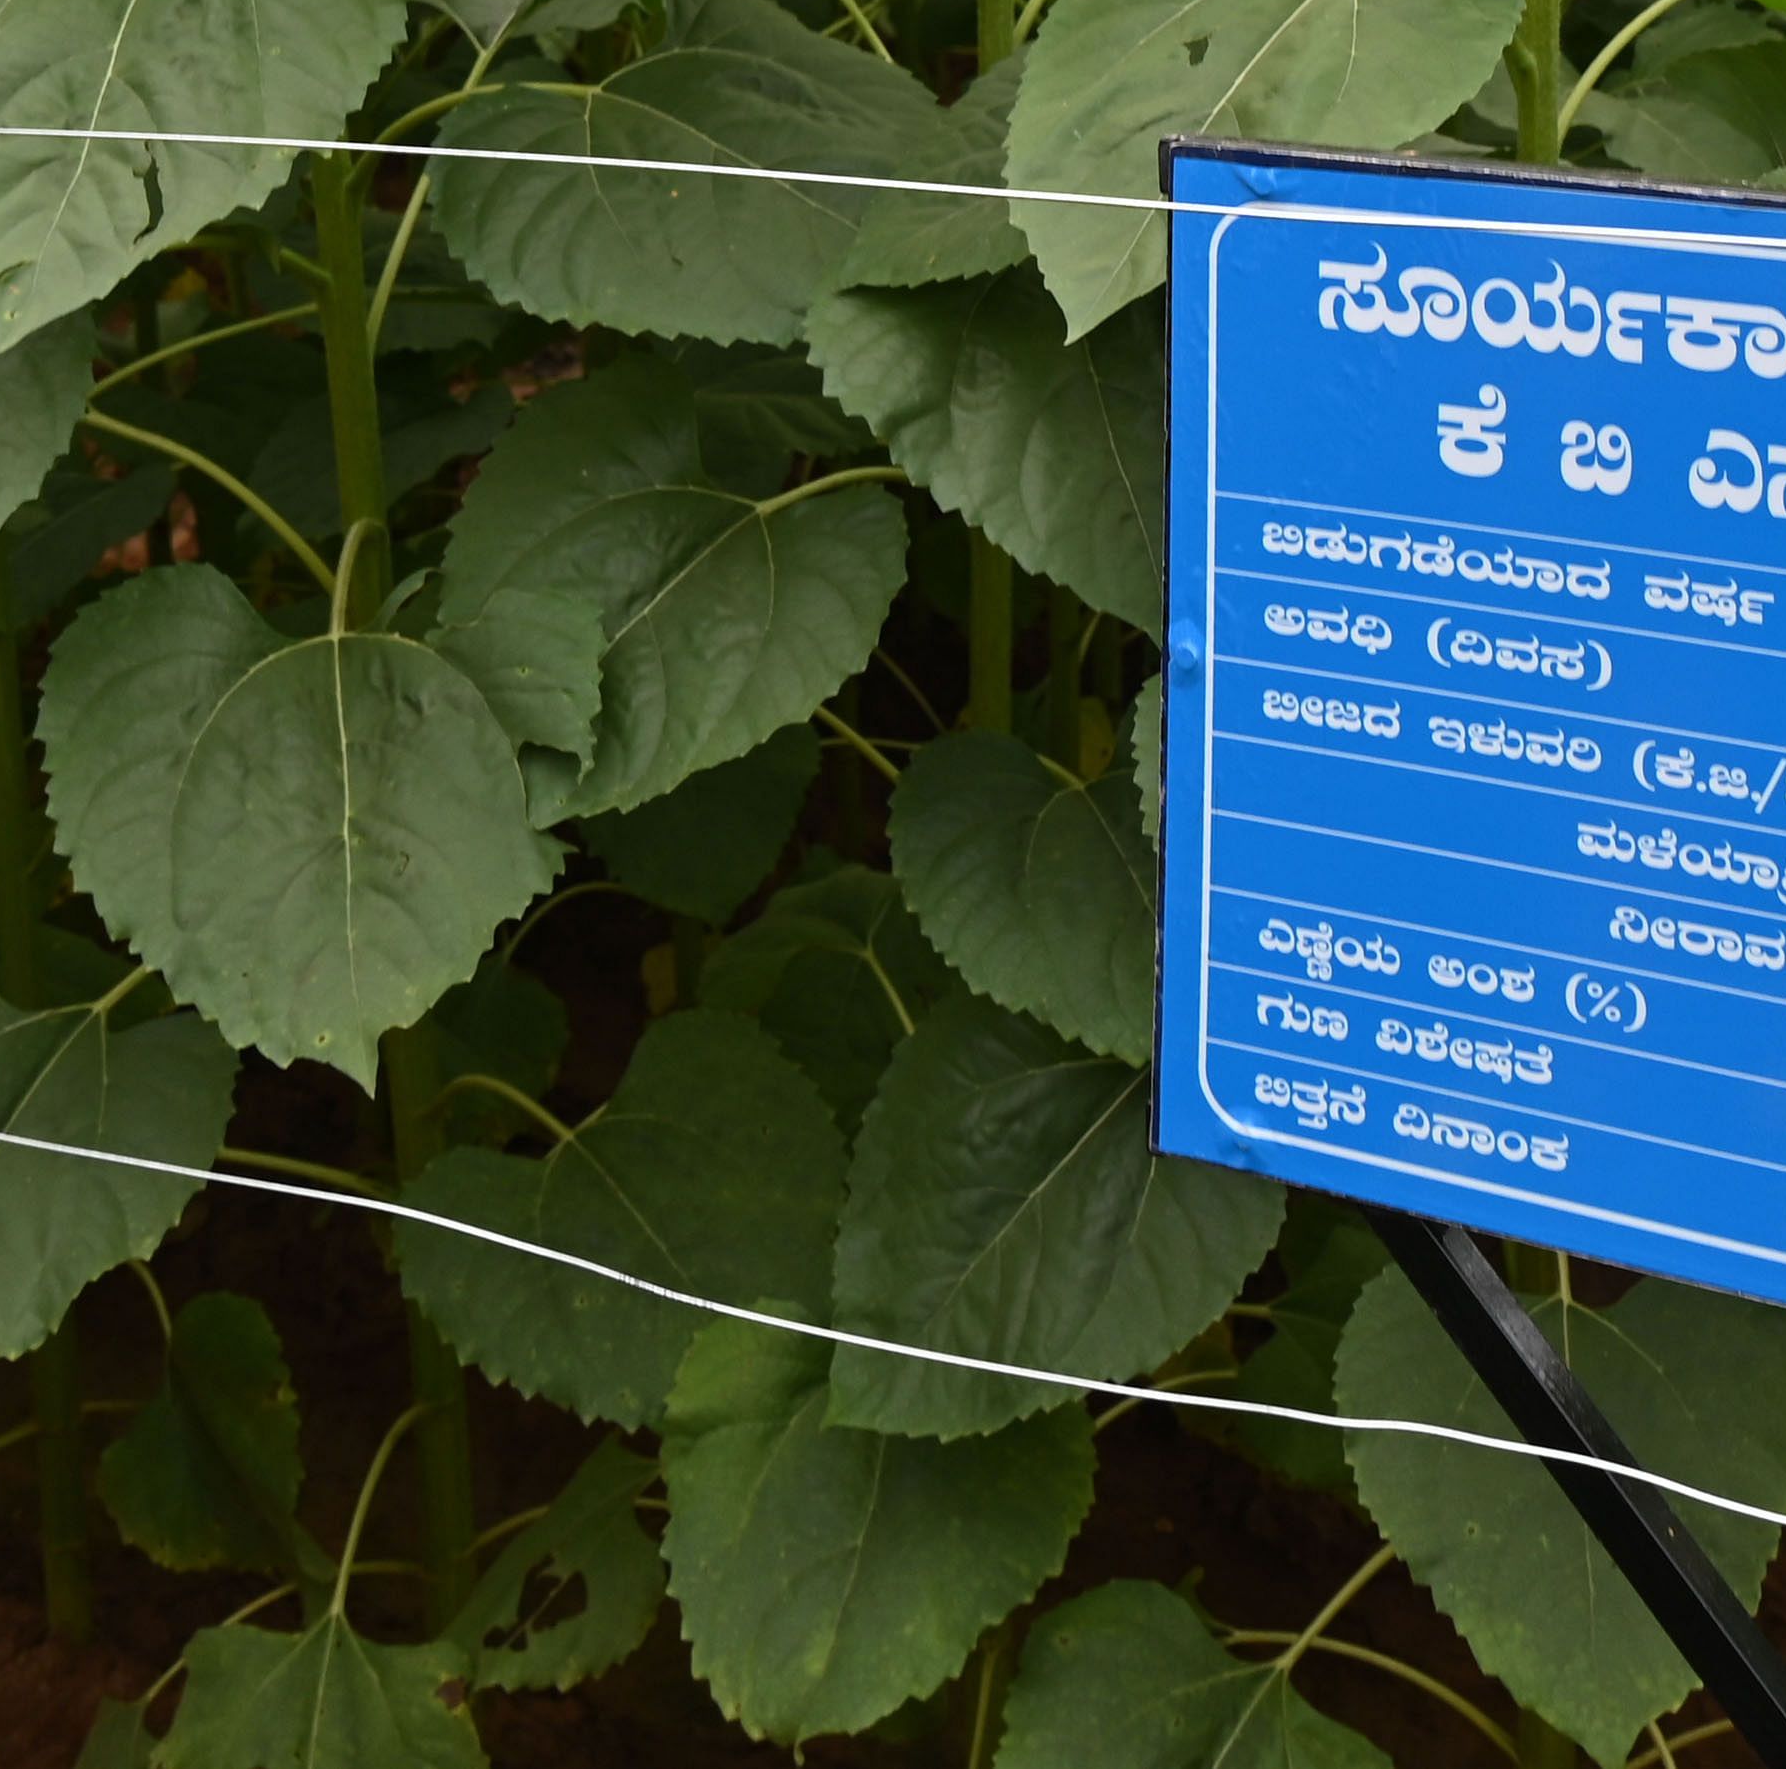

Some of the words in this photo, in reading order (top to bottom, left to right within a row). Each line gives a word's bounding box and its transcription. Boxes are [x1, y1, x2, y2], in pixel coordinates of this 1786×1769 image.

[1438, 385, 1506, 476] ಕೆ
[1561, 421, 1632, 495] ಬಿ
[1263, 523, 1610, 599] ಬಿಡುಗಡೆಯಾದ
[1645, 573, 1774, 625] ವರ್ಷ
[1265, 605, 1392, 654] ಅವಧಿ
[1428, 618, 1612, 689] (ದಿವಸ)
[1264, 691, 1400, 738] ಬೀಜದ
[1429, 717, 1601, 771] ಇಳುವರಿ
[1260, 920, 1400, 980] ಎಣ್ಣೆಯ
[1429, 956, 1534, 1001] ಅಂಶ
[1566, 974, 1646, 1031] (%)
[1258, 994, 1348, 1040] ಗುಣ
[1376, 1020, 1553, 1084] ವಿಶೇಷತೆ
[1256, 1075, 1366, 1129] ಬಿತ್ತನೆ
[1394, 1104, 1568, 1170] ದಿನಾಂಕ
